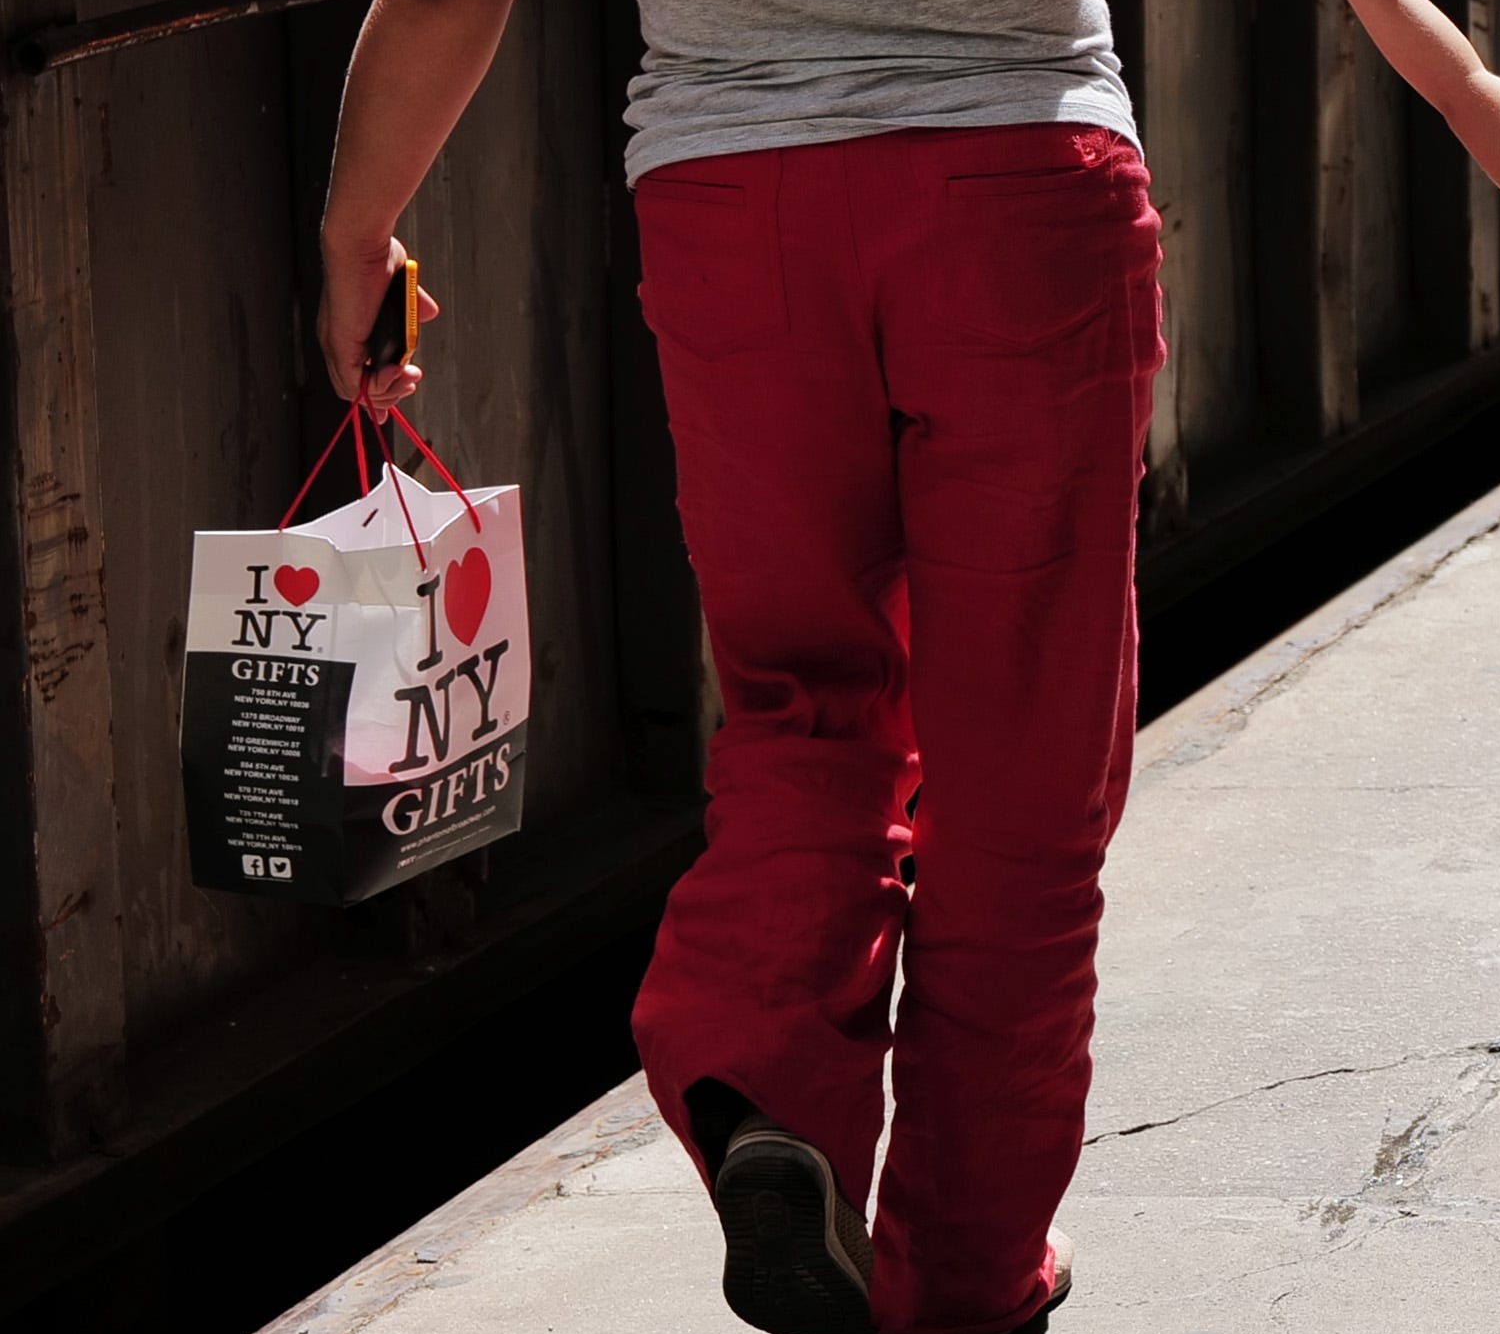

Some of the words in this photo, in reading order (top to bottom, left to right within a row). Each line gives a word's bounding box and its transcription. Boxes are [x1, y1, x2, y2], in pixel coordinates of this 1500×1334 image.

[245, 565, 270, 604] I
[416, 575, 443, 671] I
[231, 609, 327, 652] NY
[231, 659, 320, 686] GIFTS
[234, 695, 254, 703] NEW
[388, 639, 509, 774] NY
[259, 713, 301, 723] BROADWAY
[245, 737, 289, 747] GREENWICH
[228, 744, 246, 752] NEW
[224, 768, 242, 776] NEW
[270, 764, 285, 772] AVE
[382, 743, 510, 836] GIFTS
[224, 792, 240, 800] NEW
